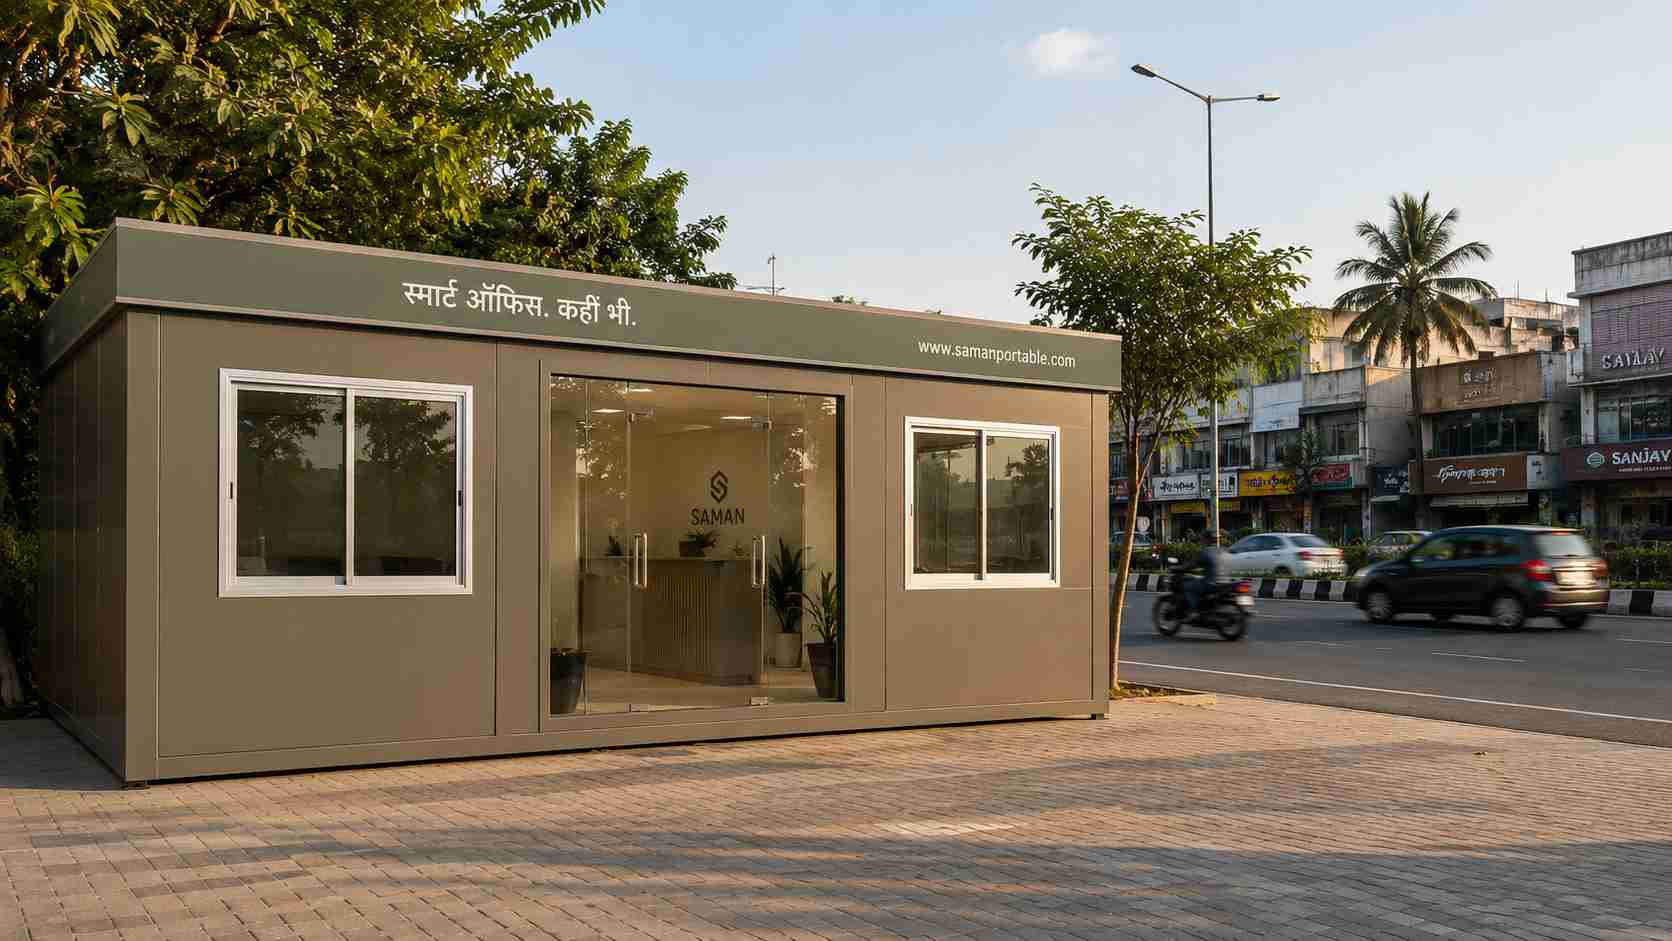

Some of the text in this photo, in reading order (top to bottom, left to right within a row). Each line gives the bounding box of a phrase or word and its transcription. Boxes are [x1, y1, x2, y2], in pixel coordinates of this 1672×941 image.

[402, 279, 637, 326] स्मार्ट ऑफिस. कहीं भी.
[918, 341, 1076, 368] www.samanportable.com
[1612, 448, 1672, 465] SANJAY
[691, 508, 745, 525] SAMAN
